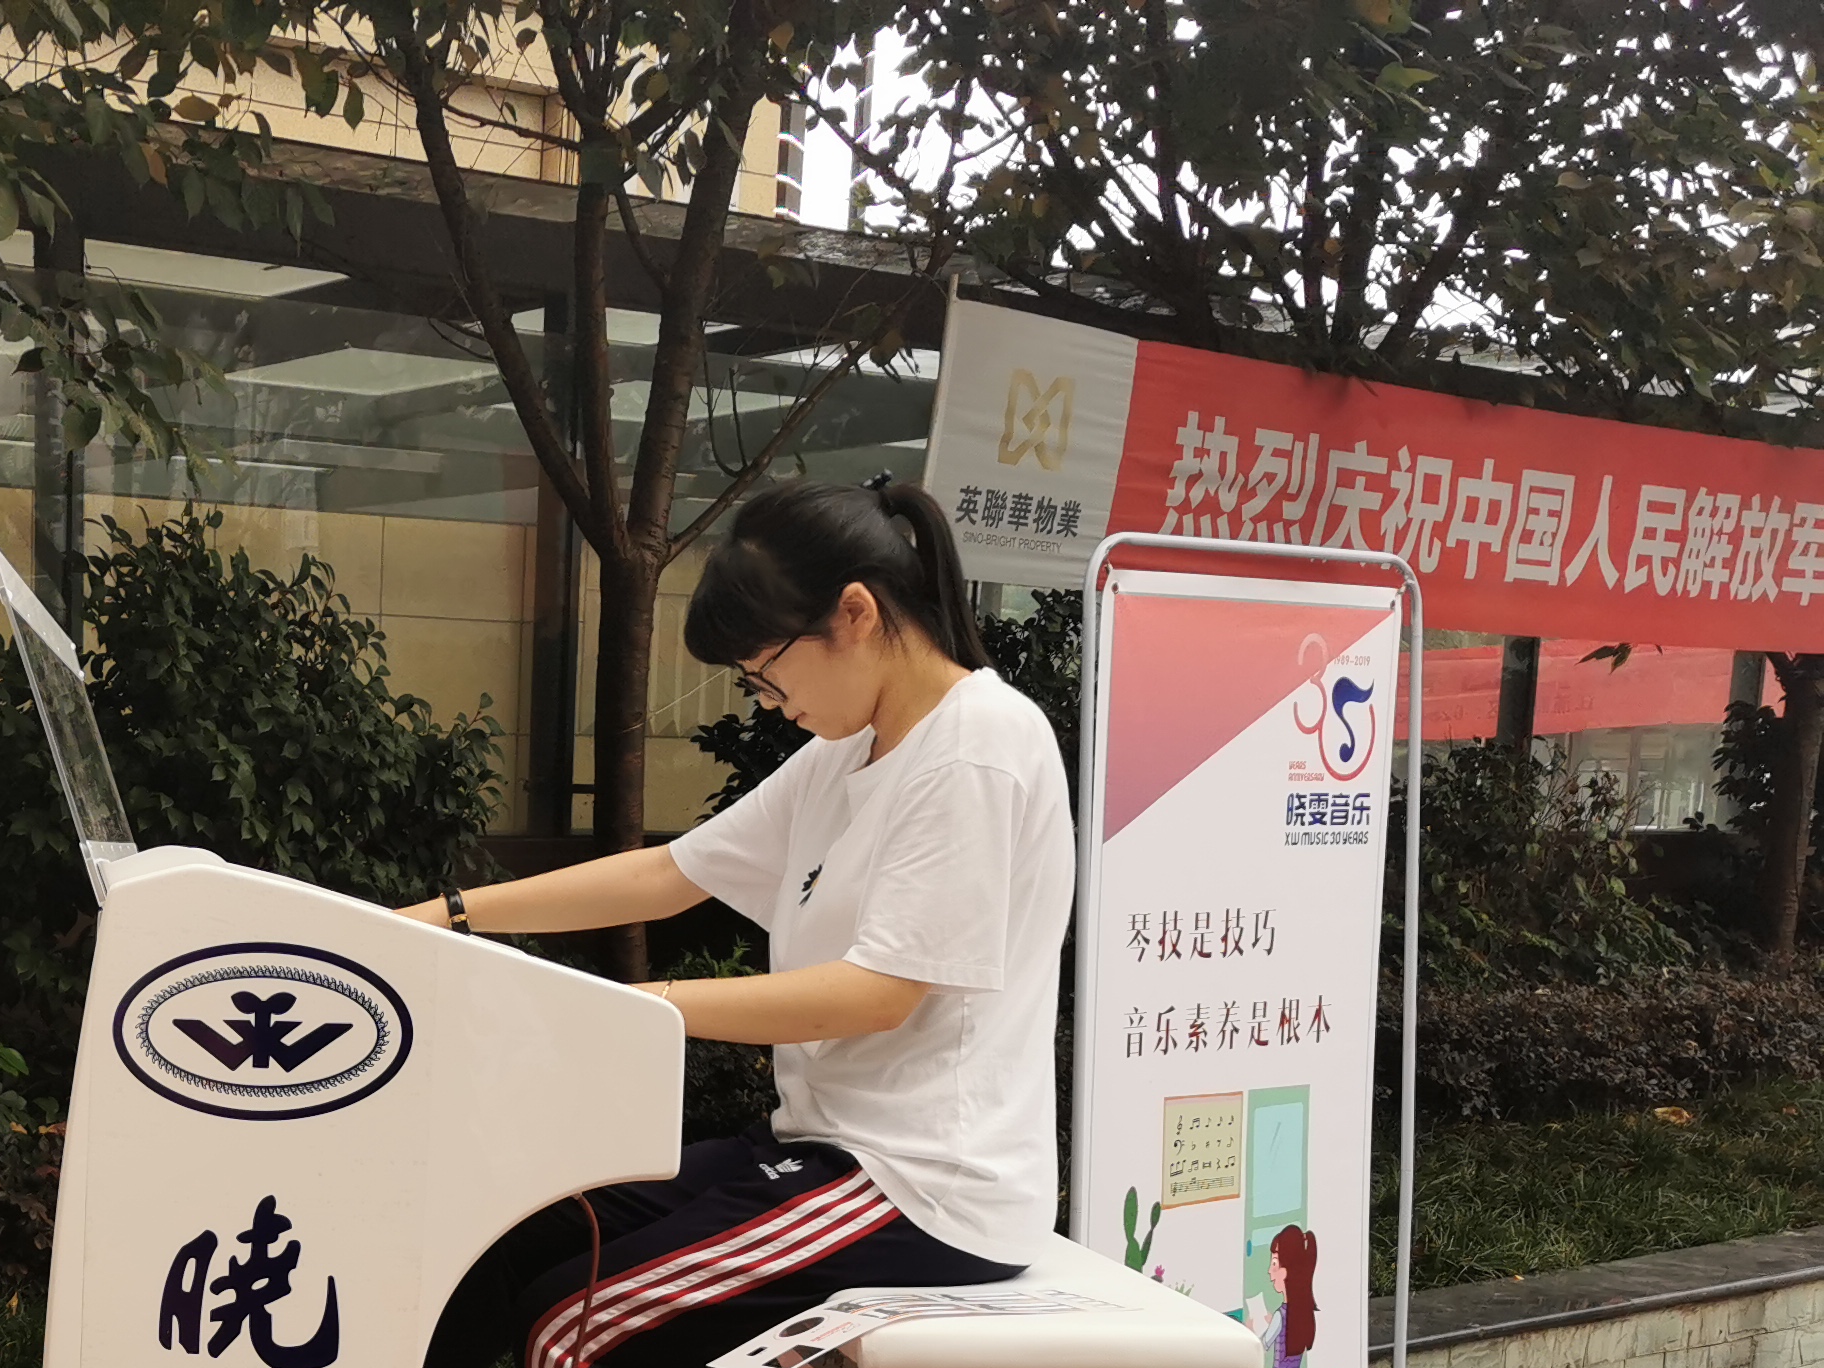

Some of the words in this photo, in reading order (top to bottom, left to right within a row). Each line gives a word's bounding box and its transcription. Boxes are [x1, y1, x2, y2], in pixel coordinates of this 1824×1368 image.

[955, 485, 1081, 538] 英聯華物業
[1158, 410, 1824, 606] 热烈庆祝中国人民解放军
[963, 531, 1016, 549] SINO-BRIGHT
[1018, 537, 1063, 553] PROPERTY
[1286, 792, 1371, 826] 晓雯音乐
[1301, 831, 1329, 845] MUSIC
[1330, 831, 1341, 845] 30
[1342, 830, 1369, 845] YEARS
[1126, 908, 1276, 963] 琴技是技巧
[1123, 995, 1332, 1058] 音乐素养是根本
